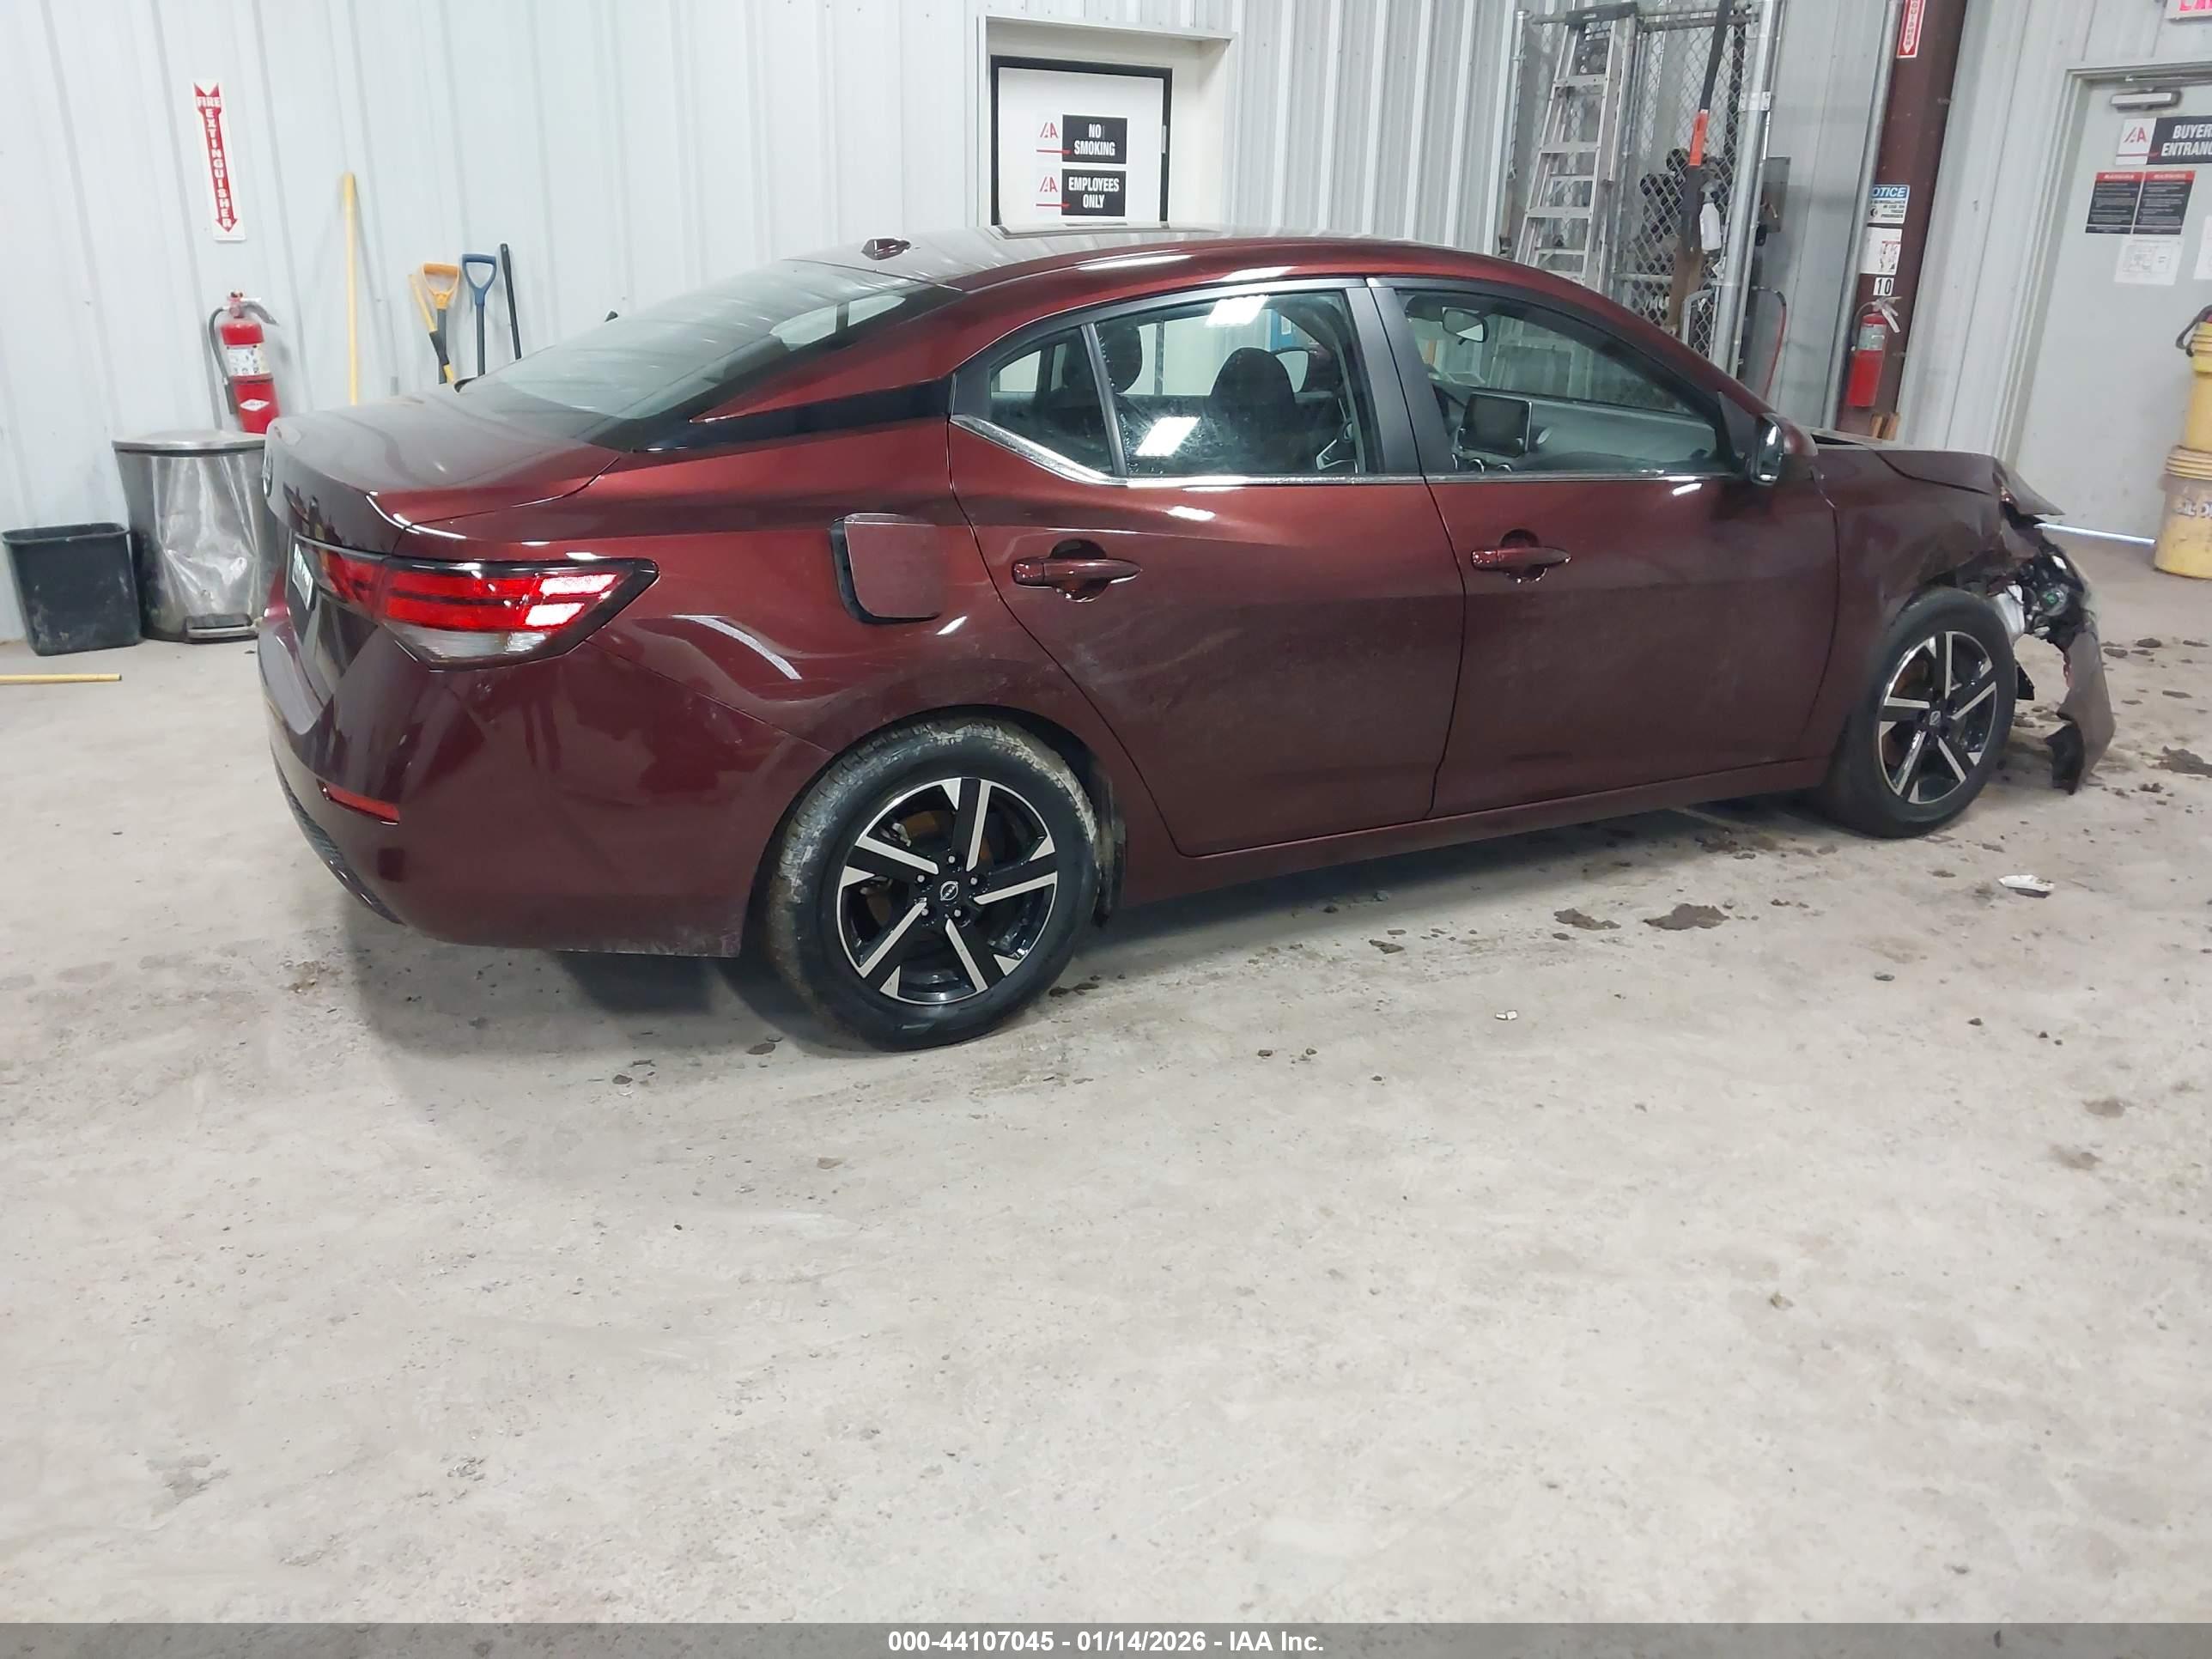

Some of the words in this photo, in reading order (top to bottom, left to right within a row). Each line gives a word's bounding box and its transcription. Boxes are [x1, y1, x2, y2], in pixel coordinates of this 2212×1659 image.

[196, 95, 221, 107] FIRE
[1088, 123, 1102, 139] NO
[1073, 139, 1115, 156] SMOKING
[205, 107, 233, 228] EXTINGUISHER
[1068, 177, 1120, 192] EMPLOYEES
[1872, 187, 1906, 198] OTICE
[1082, 193, 1105, 209] ONLY
[1877, 278, 1893, 295] 10
